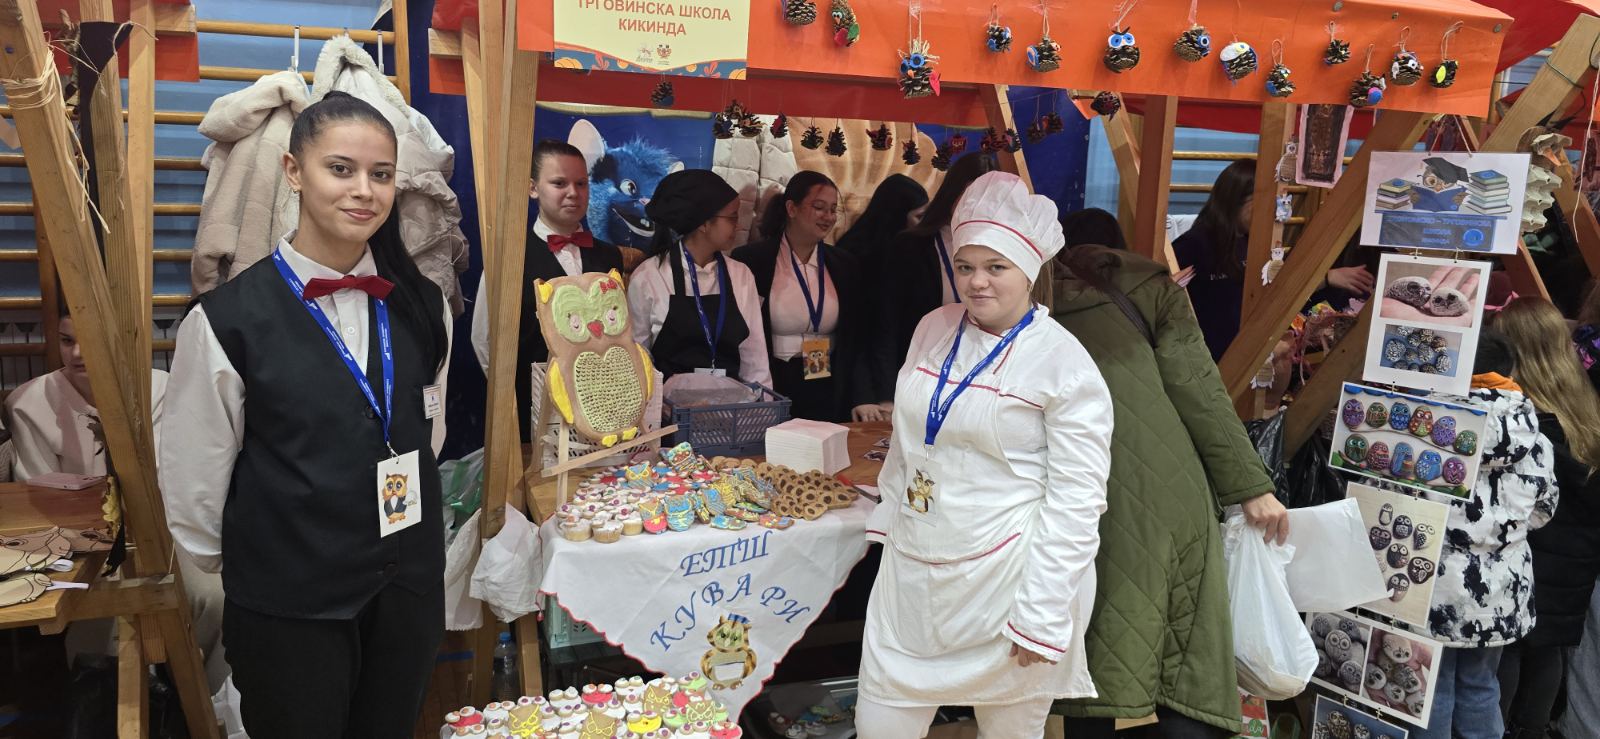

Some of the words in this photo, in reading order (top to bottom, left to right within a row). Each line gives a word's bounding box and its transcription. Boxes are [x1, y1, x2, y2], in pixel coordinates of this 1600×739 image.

[679, 4, 732, 21] ШКОЛА
[618, 18, 687, 37] КИКИНДА
[650, 573, 811, 652] КУВАРИ
